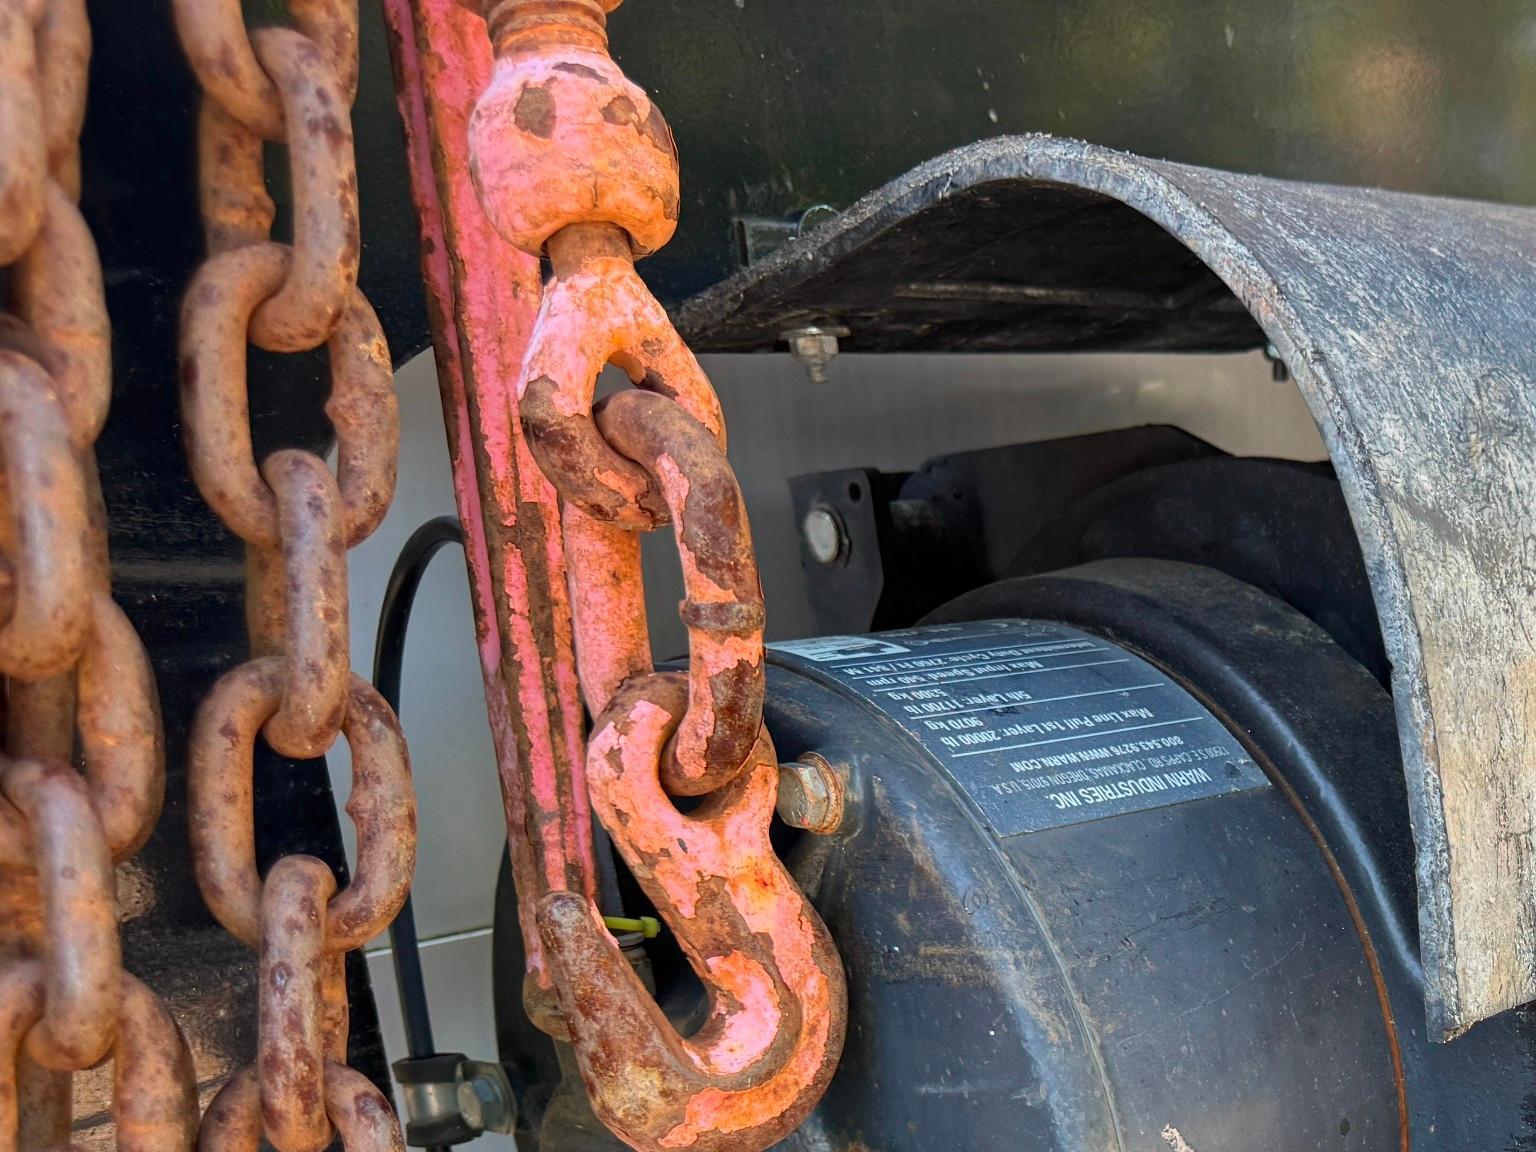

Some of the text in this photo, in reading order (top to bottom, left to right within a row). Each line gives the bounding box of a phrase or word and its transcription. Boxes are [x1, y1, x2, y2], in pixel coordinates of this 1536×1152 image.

[945, 653, 990, 662] Cycle:
[987, 649, 1022, 657] Duty
[971, 664, 1012, 674] Input
[1008, 660, 1044, 669] Max
[842, 668, 865, 676] M
[927, 668, 976, 680] Speed:
[866, 678, 898, 686] rpm
[887, 688, 948, 701] 5300 kg
[903, 690, 1032, 715] 5th Layer: 11700 lb
[924, 717, 984, 731] 9070 kg
[940, 707, 1154, 748] Max Line Pull 1st Layer: 20000 lb
[1009, 736, 1184, 772] 800.543.9276 WWW.WARN.COM
[1161, 752, 1193, 766] CAPPS
[1047, 769, 1091, 786] OREGON
[1045, 768, 1212, 809] WARN INDUSTRIES INC.
